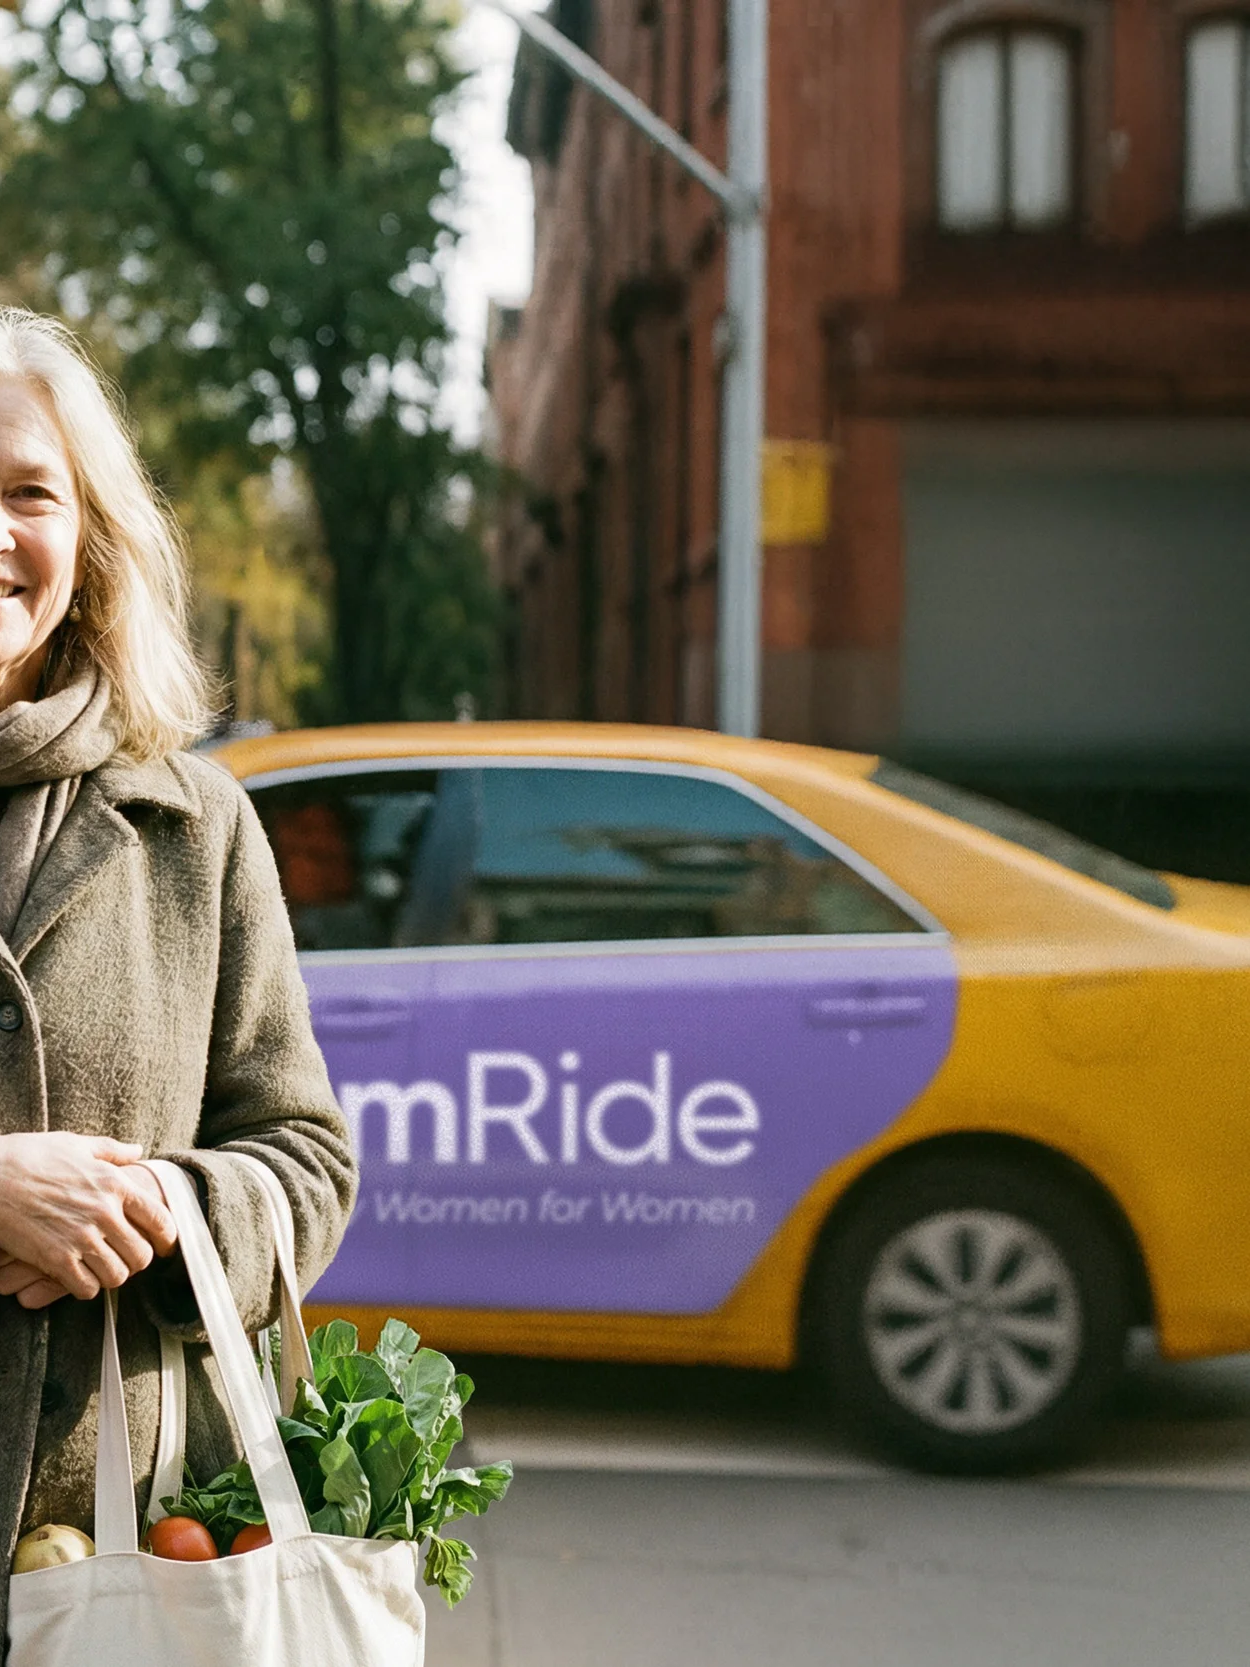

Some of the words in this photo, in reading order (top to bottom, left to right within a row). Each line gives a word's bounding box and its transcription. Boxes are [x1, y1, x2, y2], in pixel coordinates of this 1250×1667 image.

[374, 1191, 527, 1224] Women
[538, 1189, 592, 1224] for
[601, 1191, 755, 1224] Women
